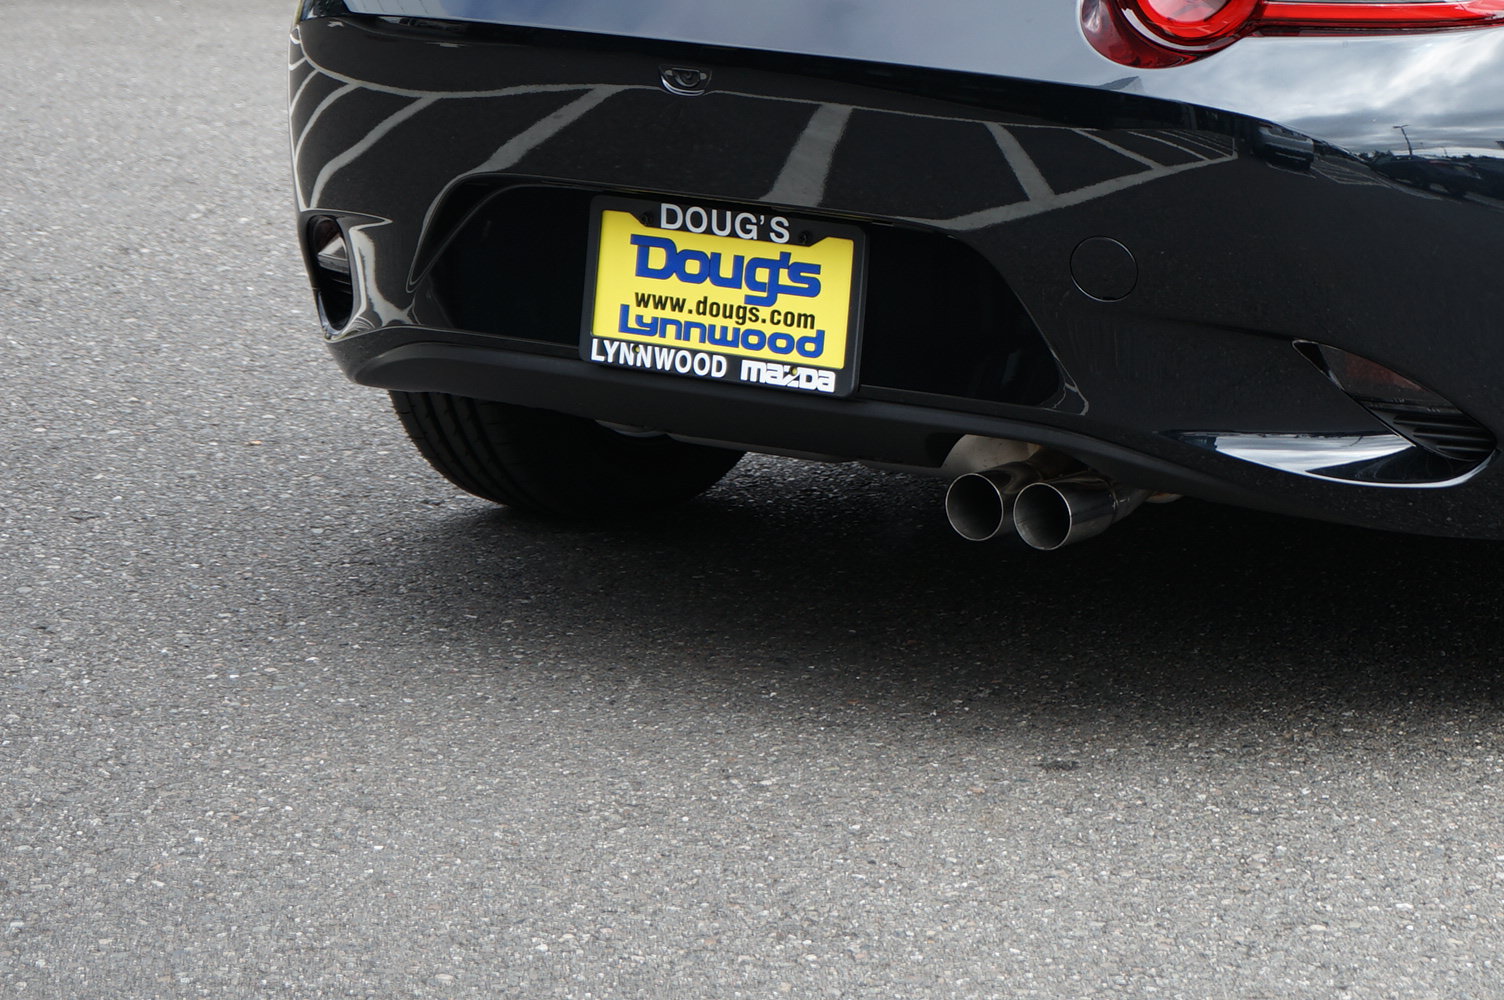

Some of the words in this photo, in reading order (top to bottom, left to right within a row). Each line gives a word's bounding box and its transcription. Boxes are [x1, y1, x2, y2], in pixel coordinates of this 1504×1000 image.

[660, 203, 790, 244] DOUG'S
[630, 233, 821, 307] Doug's
[618, 303, 826, 359] Lynnwood
[634, 291, 816, 330] www.dougs.com
[590, 338, 727, 379] LYNNWOOD
